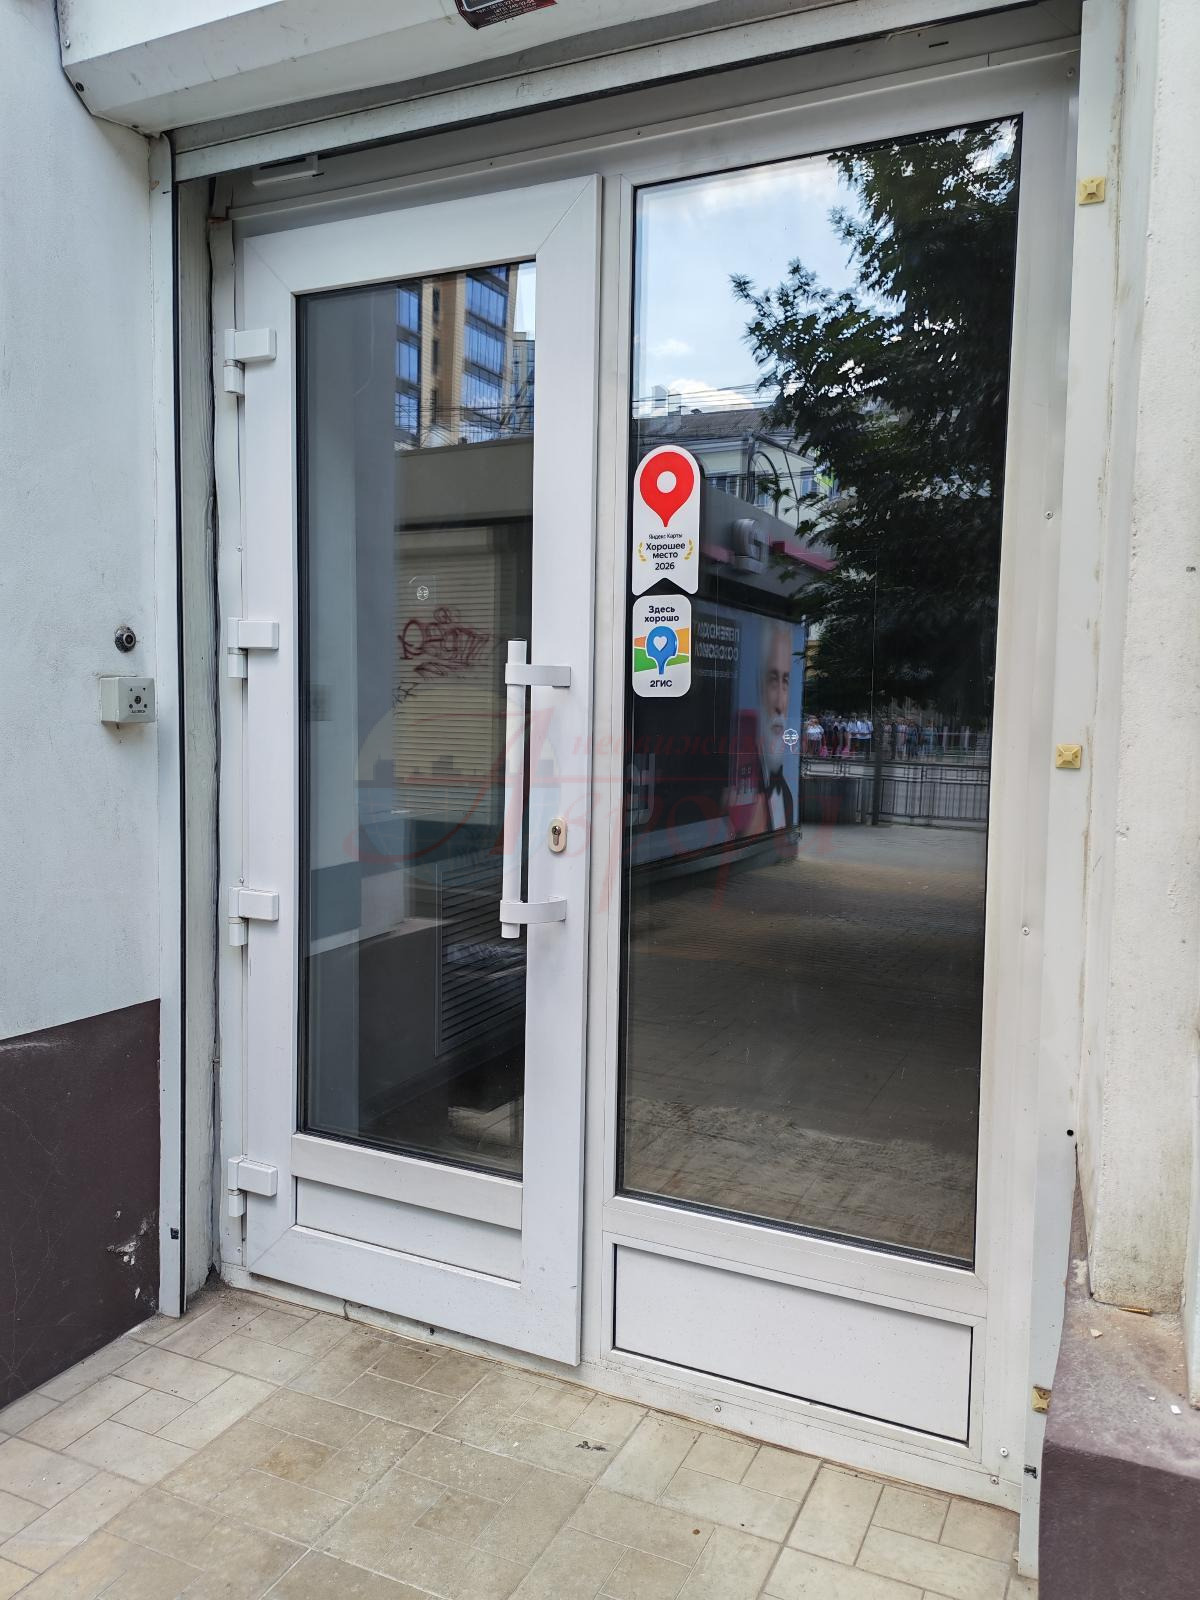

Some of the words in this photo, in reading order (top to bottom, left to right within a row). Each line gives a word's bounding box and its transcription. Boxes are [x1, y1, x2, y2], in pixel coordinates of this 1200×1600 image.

[646, 542, 686, 552] Хорошее
[652, 551, 678, 559] место
[655, 562, 675, 570] 2026
[648, 606, 676, 614] Здесь
[644, 615, 680, 624] хорошо
